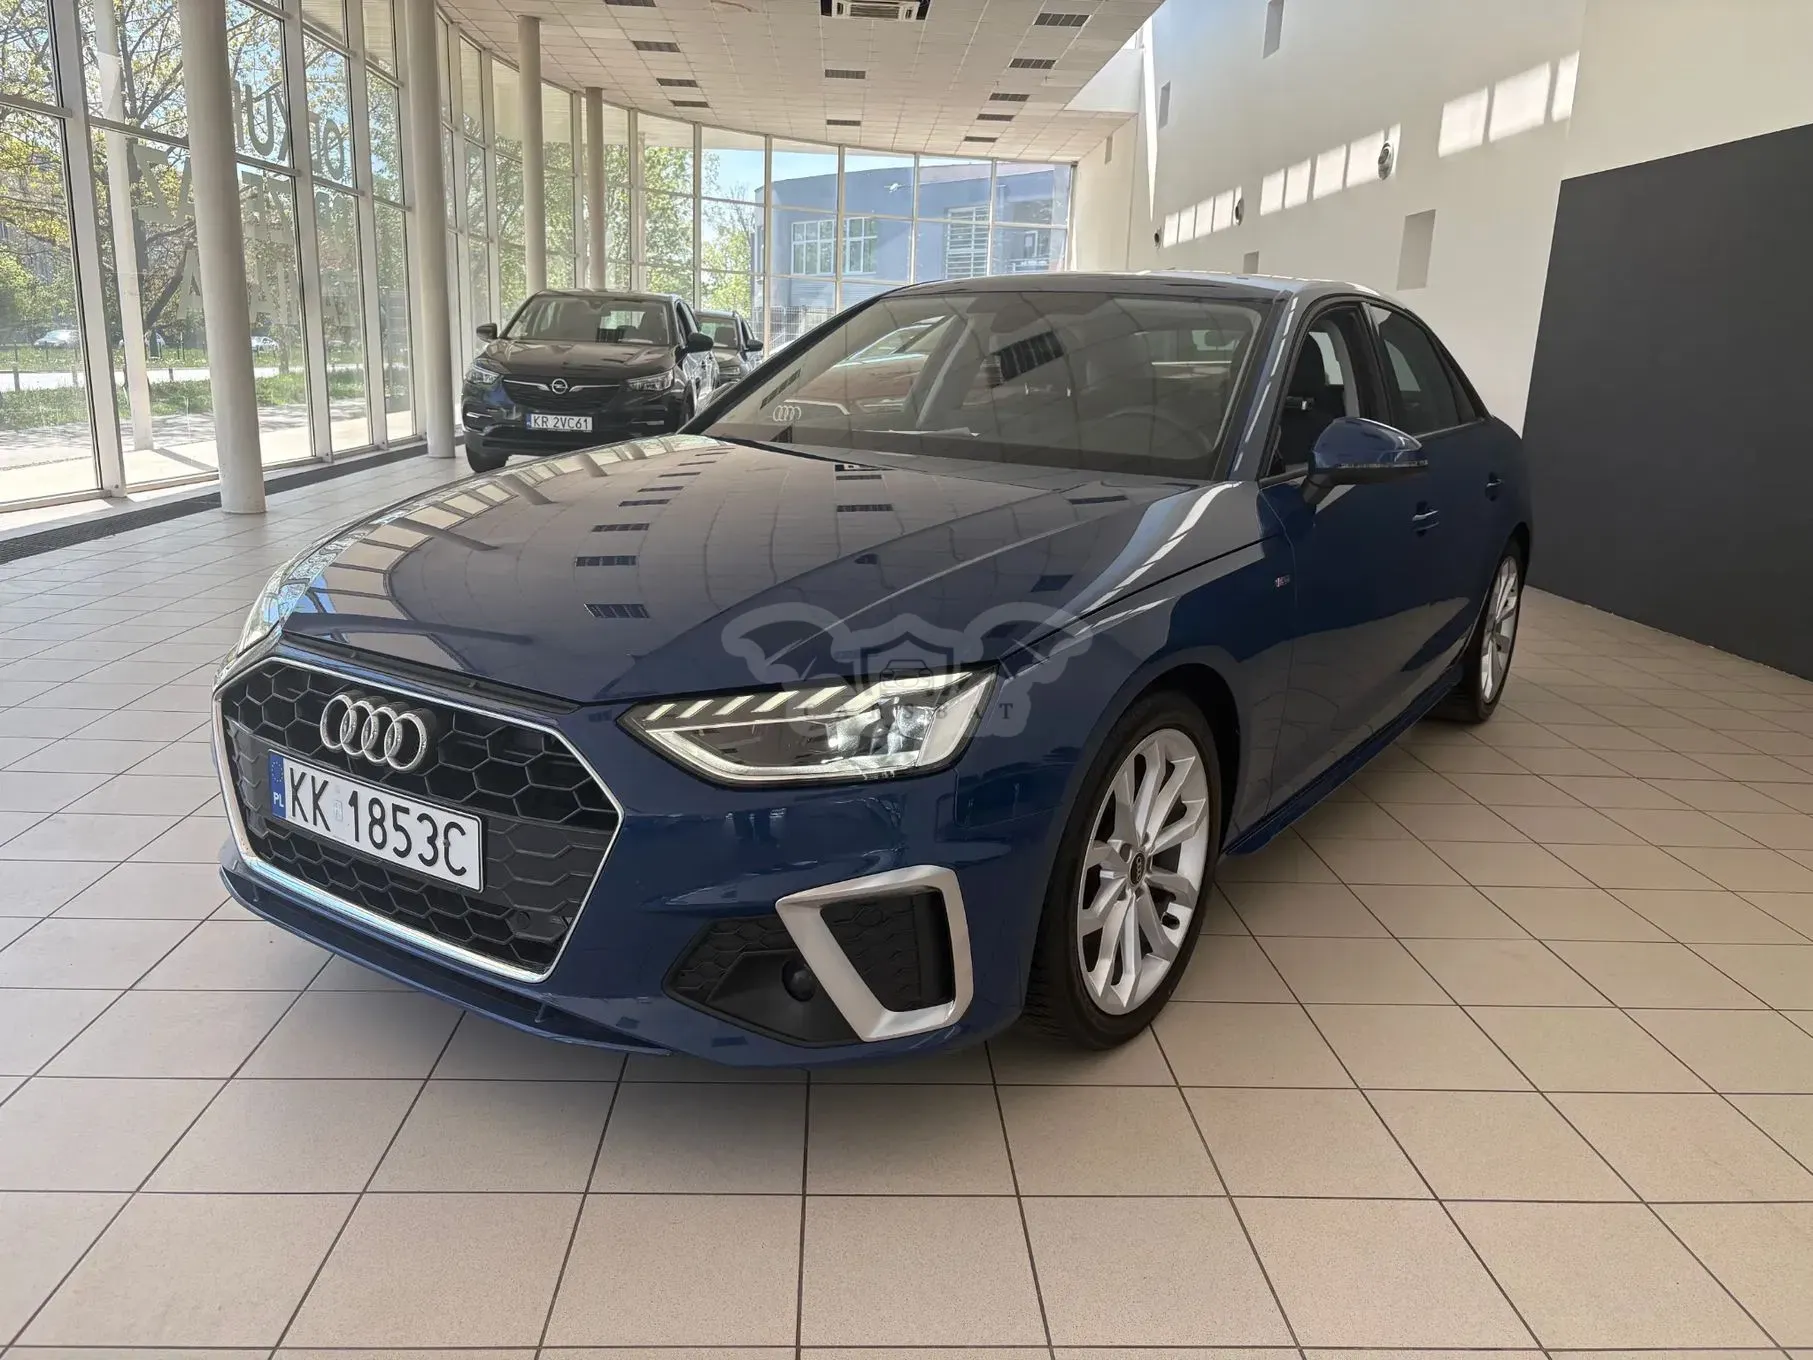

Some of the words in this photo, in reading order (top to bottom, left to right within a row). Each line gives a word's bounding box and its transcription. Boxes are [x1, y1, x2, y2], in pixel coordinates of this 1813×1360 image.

[533, 415, 548, 428] KR
[553, 416, 588, 430] 2VC61
[273, 791, 285, 808] PL
[289, 767, 331, 832] KK
[348, 790, 467, 877] 1853C
